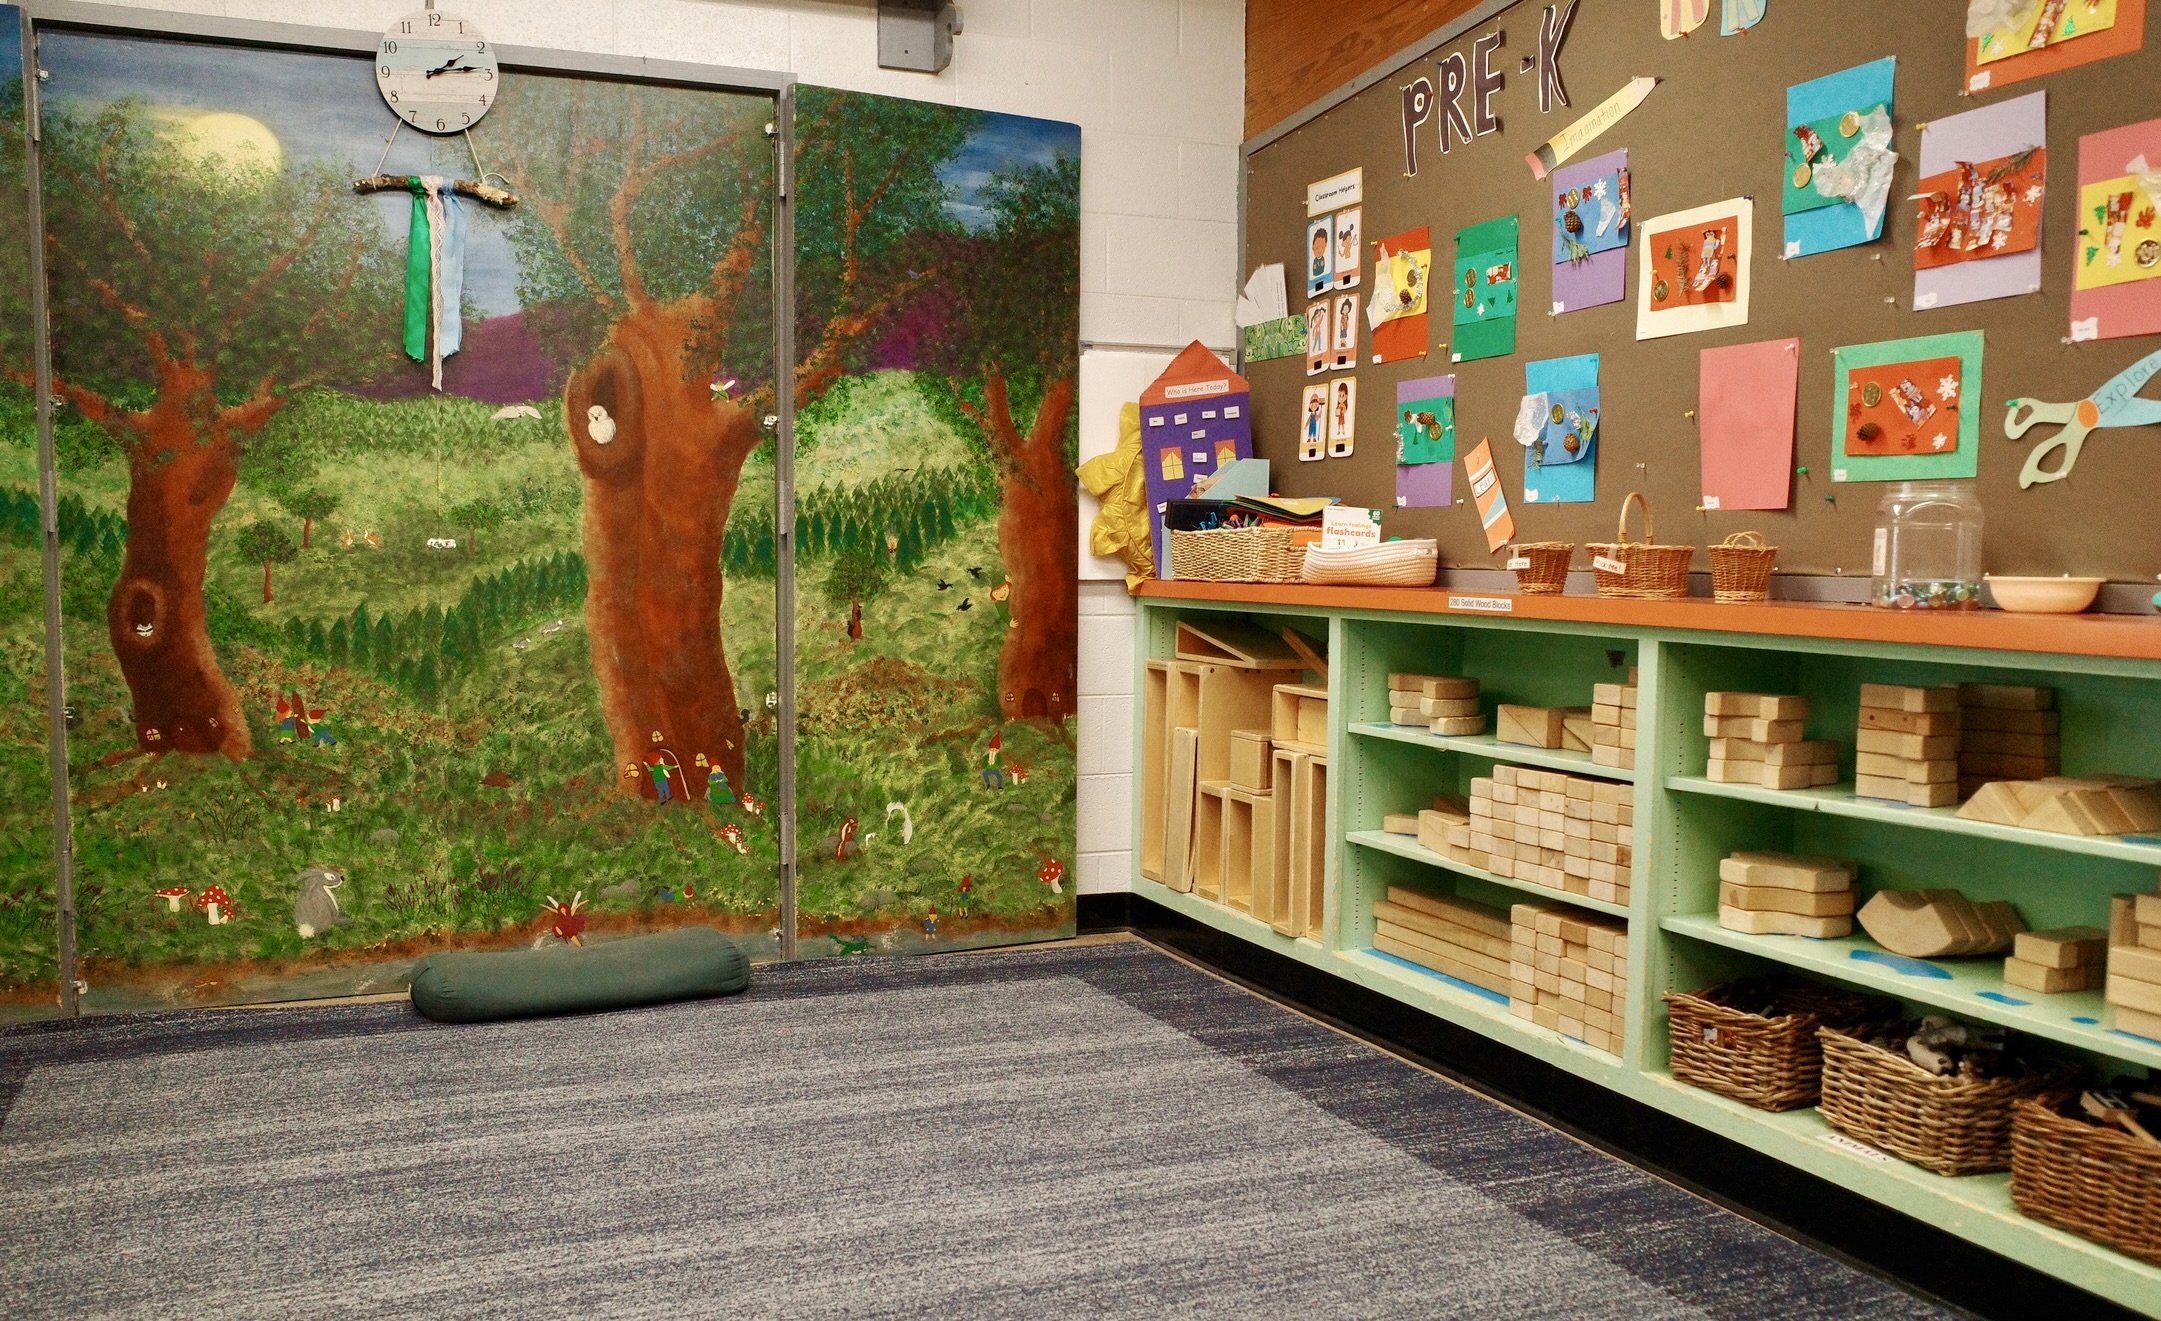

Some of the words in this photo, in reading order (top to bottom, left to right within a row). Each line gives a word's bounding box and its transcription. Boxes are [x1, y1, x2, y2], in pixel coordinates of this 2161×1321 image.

[428, 13, 441, 27] 12
[401, 21, 412, 34] 11
[458, 21, 464, 34] 1
[383, 41, 398, 54] 10
[476, 41, 486, 54] 2
[381, 65, 391, 78] 9
[484, 68, 493, 82] 3
[390, 90, 399, 103] 8
[478, 94, 487, 106] 4
[408, 110, 417, 123] 7
[461, 112, 471, 125] 5
[436, 118, 446, 131] 6
[1559, 102, 1622, 153] Imagination
[1314, 190, 1338, 202] Classroom
[1338, 184, 1356, 195] Helpers
[1166, 388, 1181, 396] Who
[1205, 382, 1227, 391] Today?
[2093, 358, 2159, 415] Explore
[1326, 526, 1376, 538] flashcards
[1349, 521, 1372, 530] feelings
[1450, 598, 1460, 606] 280
[1461, 598, 1474, 607] Solid
[1475, 599, 1491, 609] Wood
[1492, 600, 1511, 610] Blocks
